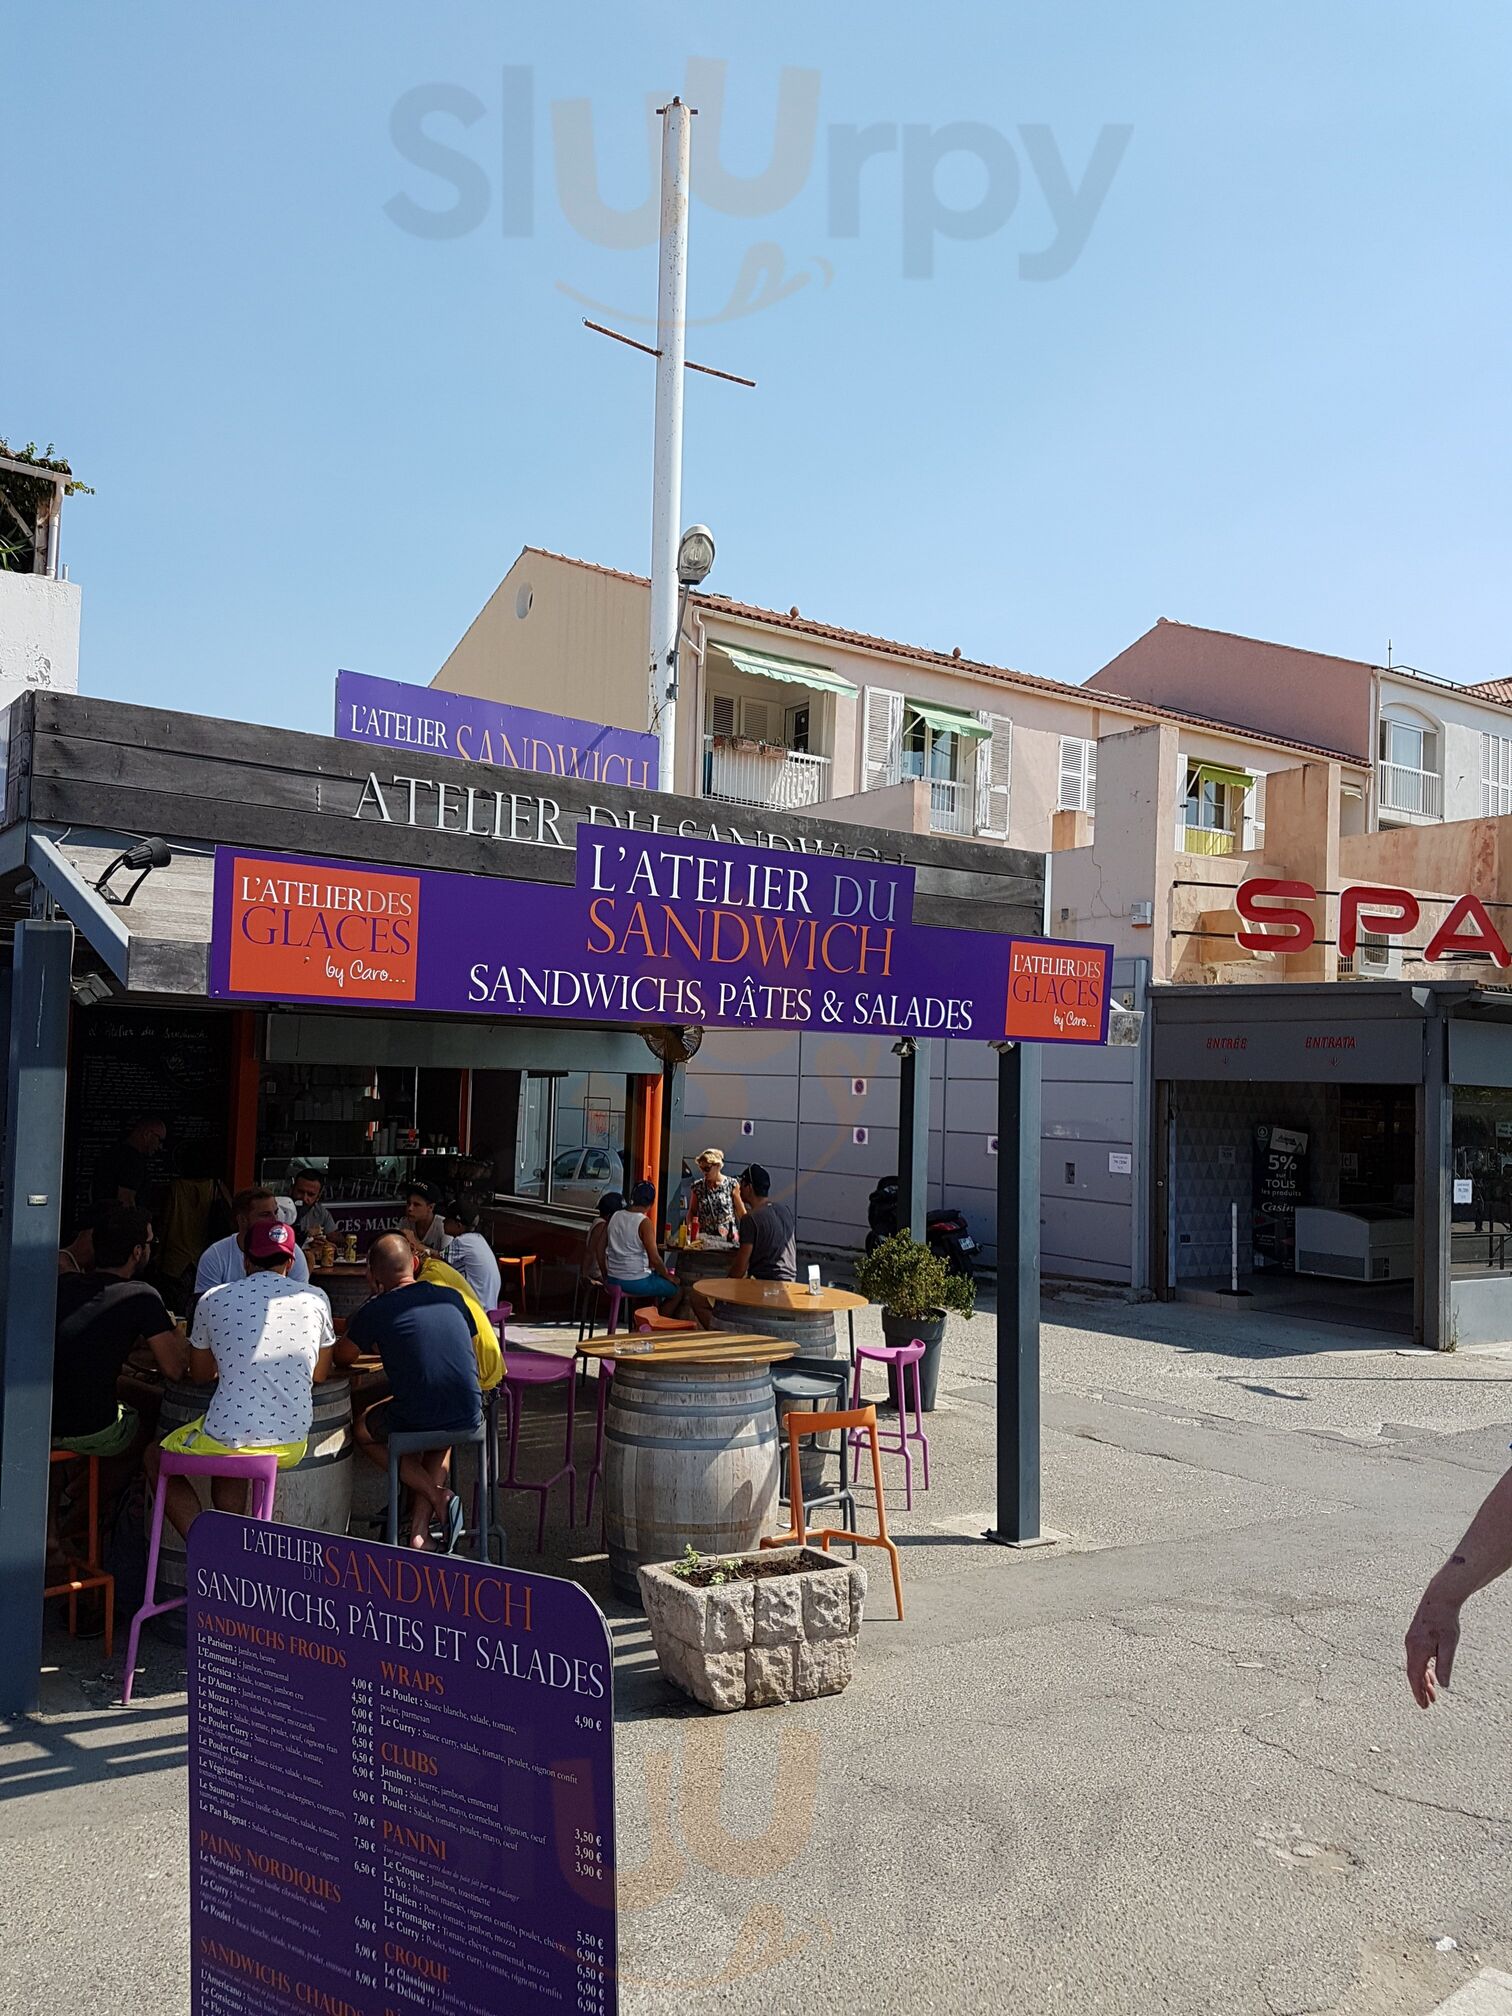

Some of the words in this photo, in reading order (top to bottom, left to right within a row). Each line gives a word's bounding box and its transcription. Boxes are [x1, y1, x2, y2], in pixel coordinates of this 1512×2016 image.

[351, 704, 448, 750] L'ATELIER
[352, 771, 567, 847] ATELIER
[590, 844, 813, 914] L'ATELIER
[832, 874, 899, 922] DU
[241, 876, 364, 912] L'ATELIER
[366, 889, 412, 916] DES
[241, 905, 411, 955] GLACES
[1234, 877, 1512, 969] SPA
[587, 897, 897, 976] SANDWICH
[326, 955, 344, 988] by
[1013, 954, 1075, 977] L'ATELIER
[1076, 960, 1101, 978] DES
[468, 963, 707, 1020] SANDWICHS,
[718, 975, 812, 1021] PÂTES
[821, 990, 845, 1023] &
[852, 991, 975, 1032] SALADES
[1013, 974, 1100, 1007] GLACES
[1053, 1008, 1064, 1032] by
[1306, 1036, 1357, 1050] ENTRATA
[1268, 1154, 1297, 1170] 5%
[1265, 1179, 1297, 1189] TOUS
[1261, 1202, 1295, 1213] Casin
[336, 1218, 361, 1233] CES
[365, 1217, 404, 1231] MAIS
[243, 1528, 324, 1567] L'ATELIER
[303, 1565, 321, 1583] DU
[325, 1547, 531, 1630] SANDWICH
[197, 1569, 339, 1633] SANDWICHS,
[349, 1602, 424, 1652] PÂTES
[434, 1625, 467, 1662] ET
[476, 1636, 603, 1698] SALADES
[197, 1612, 285, 1650] SANDWICHS
[290, 1636, 346, 1668] FROIDS
[197, 1632, 206, 1644] Le
[207, 1635, 233, 1651] Parisien
[198, 1659, 207, 1670] Le
[207, 1662, 232, 1678] Corsica
[381, 1661, 444, 1695] WRAPS
[198, 1672, 207, 1684] Le
[207, 1675, 237, 1693] D'Amore
[351, 1677, 367, 1690] 4,00
[367, 1681, 373, 1692] €
[198, 1685, 207, 1697] Le
[207, 1689, 230, 1704] Mozza
[351, 1692, 367, 1705] 4,50
[368, 1696, 373, 1707] €
[380, 1685, 391, 1697] Le
[392, 1688, 418, 1705] Poulet
[198, 1698, 207, 1710] Le
[208, 1702, 229, 1718] Poulet
[351, 1706, 367, 1720] 6,00
[368, 1711, 374, 1722] €
[198, 1712, 207, 1724] Le
[208, 1715, 229, 1731] Poulet
[229, 1723, 249, 1741] Curry
[351, 1720, 367, 1734] 7,00
[368, 1726, 374, 1736] €
[380, 1714, 391, 1727] Le
[392, 1718, 416, 1737] Curry
[574, 1715, 594, 1729] 4,90
[596, 1720, 602, 1732] €
[198, 1734, 207, 1746] Le
[208, 1737, 229, 1753] Poulet
[230, 1745, 249, 1761] César
[351, 1735, 368, 1749] 6,50
[368, 1740, 374, 1751] €
[199, 1756, 208, 1768] Le
[208, 1759, 244, 1781] Végétarien
[352, 1750, 368, 1764] 6,50
[369, 1755, 374, 1766] €
[381, 1742, 438, 1776] CLUBS
[380, 1764, 412, 1783] Jambon
[199, 1777, 208, 1789] Le
[208, 1782, 236, 1800] Saumon
[381, 1779, 403, 1796] Thon
[199, 1799, 208, 1812] Le
[209, 1803, 222, 1817] Pan
[223, 1809, 247, 1827] Bagnat
[382, 1794, 407, 1812] Poulet
[383, 1820, 446, 1860] PANINI
[574, 1828, 594, 1844] 3,50
[595, 1835, 602, 1847] €
[200, 1850, 209, 1862] Le
[209, 1854, 244, 1877] Norvégien
[575, 1844, 594, 1861] 3,90
[596, 1852, 602, 1864] €
[200, 1830, 242, 1862] PAINS
[247, 1849, 341, 1902] NORDIQUES
[383, 1856, 394, 1869] Le
[395, 1861, 425, 1881] Croque
[575, 1861, 595, 1877] 3,90
[596, 1868, 603, 1880] €
[200, 1875, 209, 1887] Le
[383, 1871, 394, 1884] Le
[395, 1875, 407, 1889] Yo
[200, 1900, 208, 1912] Le
[384, 1885, 417, 1908] L'Italien
[384, 1900, 395, 1914] Le
[396, 1906, 436, 1931] Fromager
[384, 1915, 395, 1929] Le
[396, 1921, 420, 1942] Curry
[576, 1930, 596, 1947] 5,50
[597, 1938, 604, 1950] €
[576, 1947, 596, 1964] 6,90
[597, 1955, 604, 1967] €
[384, 1962, 395, 1976] Le
[396, 1968, 435, 1994] Classique
[576, 1964, 596, 1980] 6,50
[598, 1971, 604, 1984] €
[200, 1982, 210, 1995] Le
[384, 1977, 395, 1991] Le
[397, 1982, 425, 2005] Deluxe
[577, 1980, 597, 1997] 6,90
[598, 1988, 605, 2001] €
[201, 1995, 210, 2008] Le
[577, 1997, 597, 2014] 6,90
[598, 2005, 605, 2016] €
